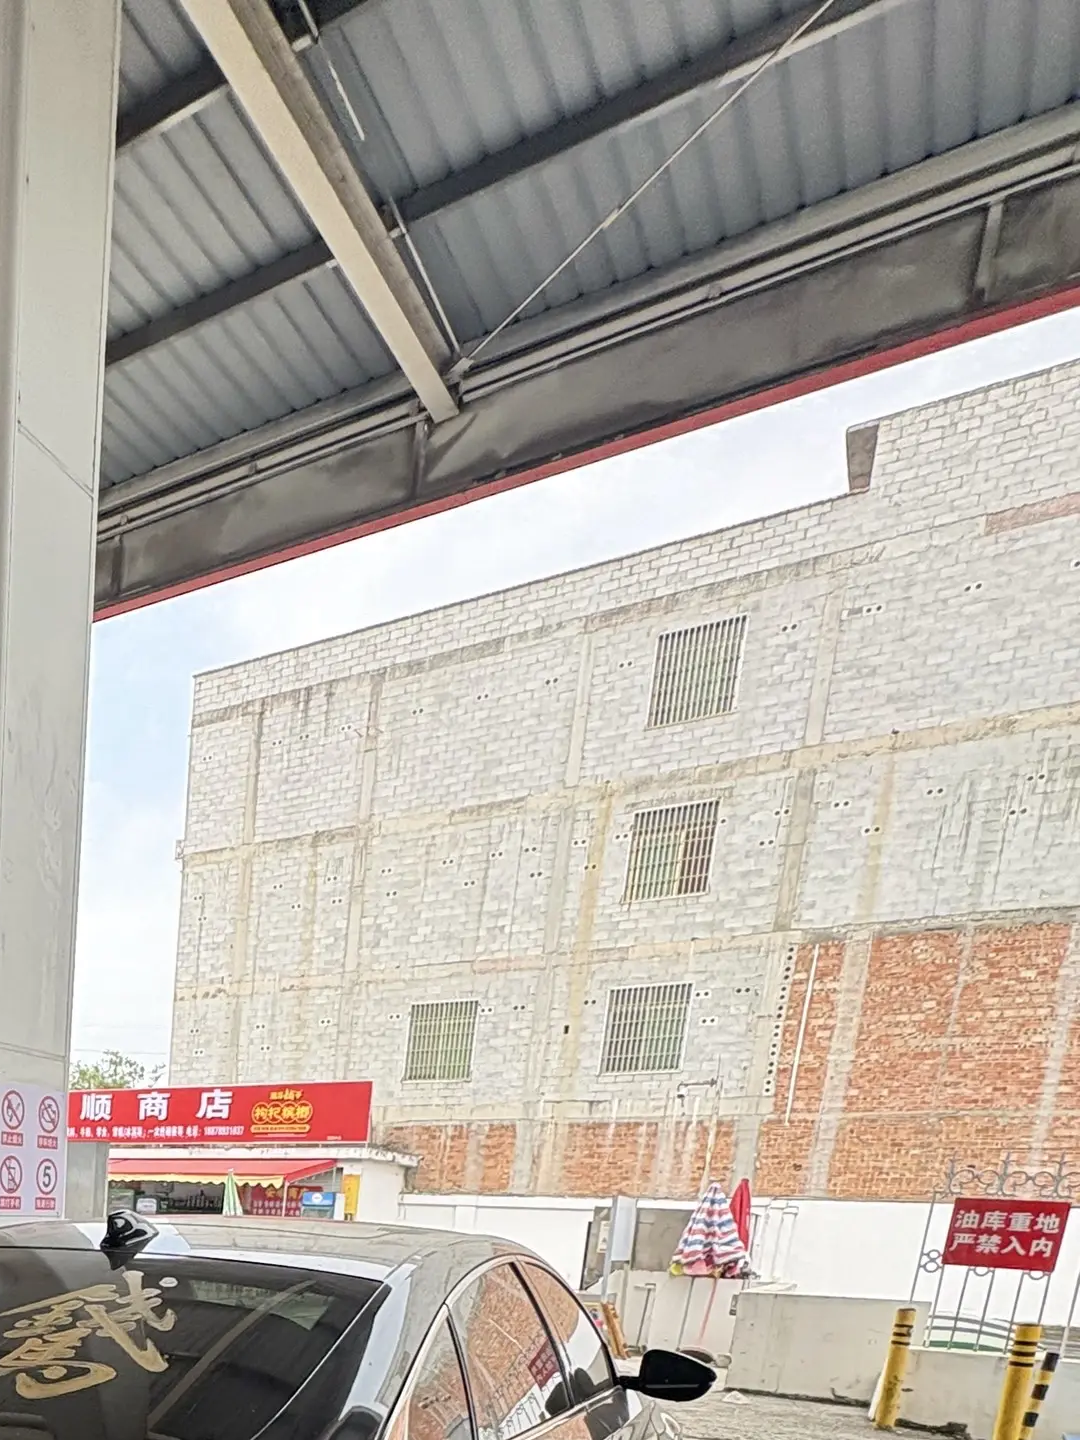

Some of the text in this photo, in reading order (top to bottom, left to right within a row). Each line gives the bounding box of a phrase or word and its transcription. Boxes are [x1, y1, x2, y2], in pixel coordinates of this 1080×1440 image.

[42, 1166, 51, 1187] 5
[954, 1210, 1061, 1234] 油库重地
[949, 1232, 1053, 1258] 严禁入内
